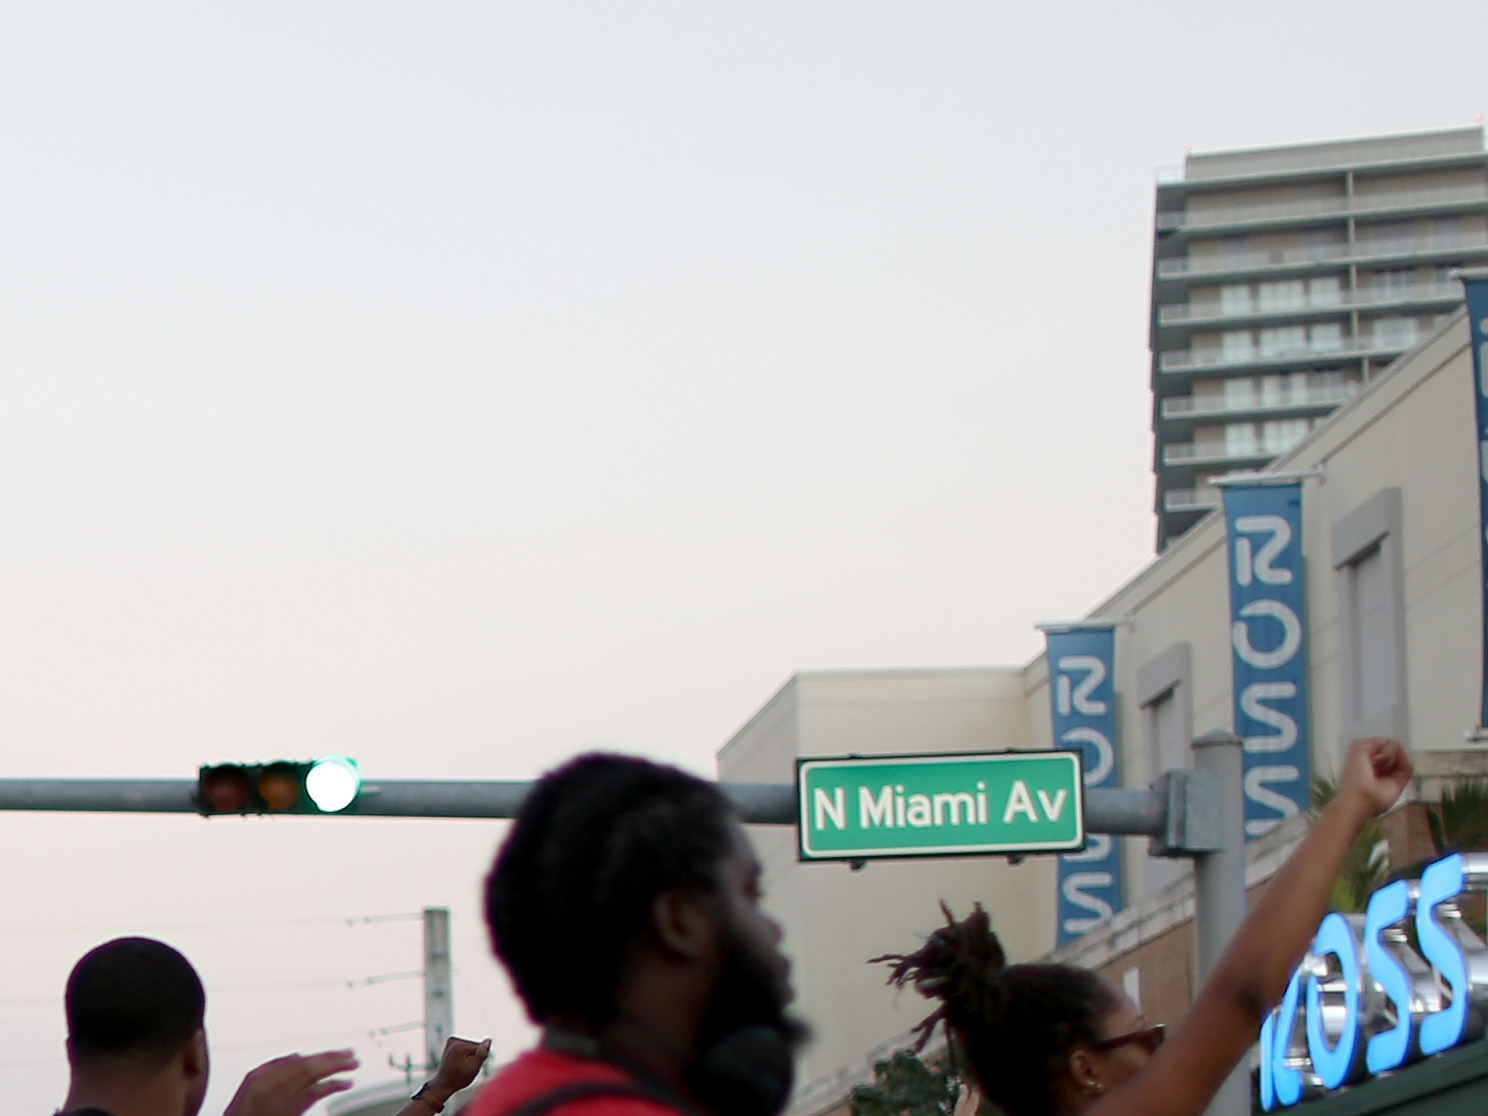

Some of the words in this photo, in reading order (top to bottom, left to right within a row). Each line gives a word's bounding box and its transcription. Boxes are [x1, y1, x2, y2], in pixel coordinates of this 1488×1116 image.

[1231, 514, 1302, 836] ROSS
[813, 786, 846, 831] N
[858, 781, 988, 829] Miami
[1002, 779, 1068, 824] Av
